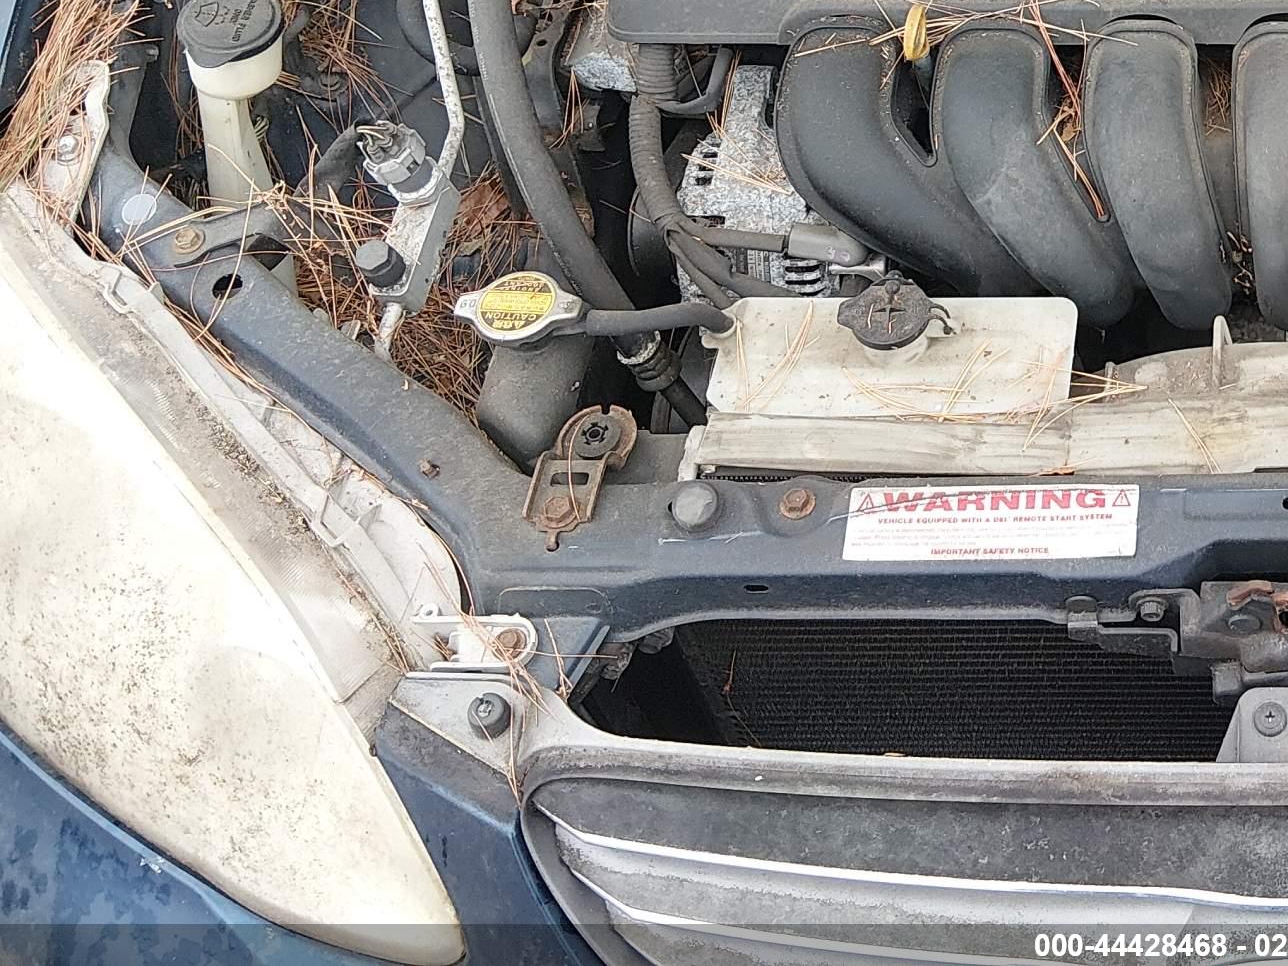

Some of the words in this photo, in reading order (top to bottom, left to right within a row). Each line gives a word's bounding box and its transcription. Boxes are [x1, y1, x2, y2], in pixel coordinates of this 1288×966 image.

[232, 22, 246, 42] FLUID
[485, 312, 536, 320] CAUTION
[883, 490, 1106, 512] WARNING
